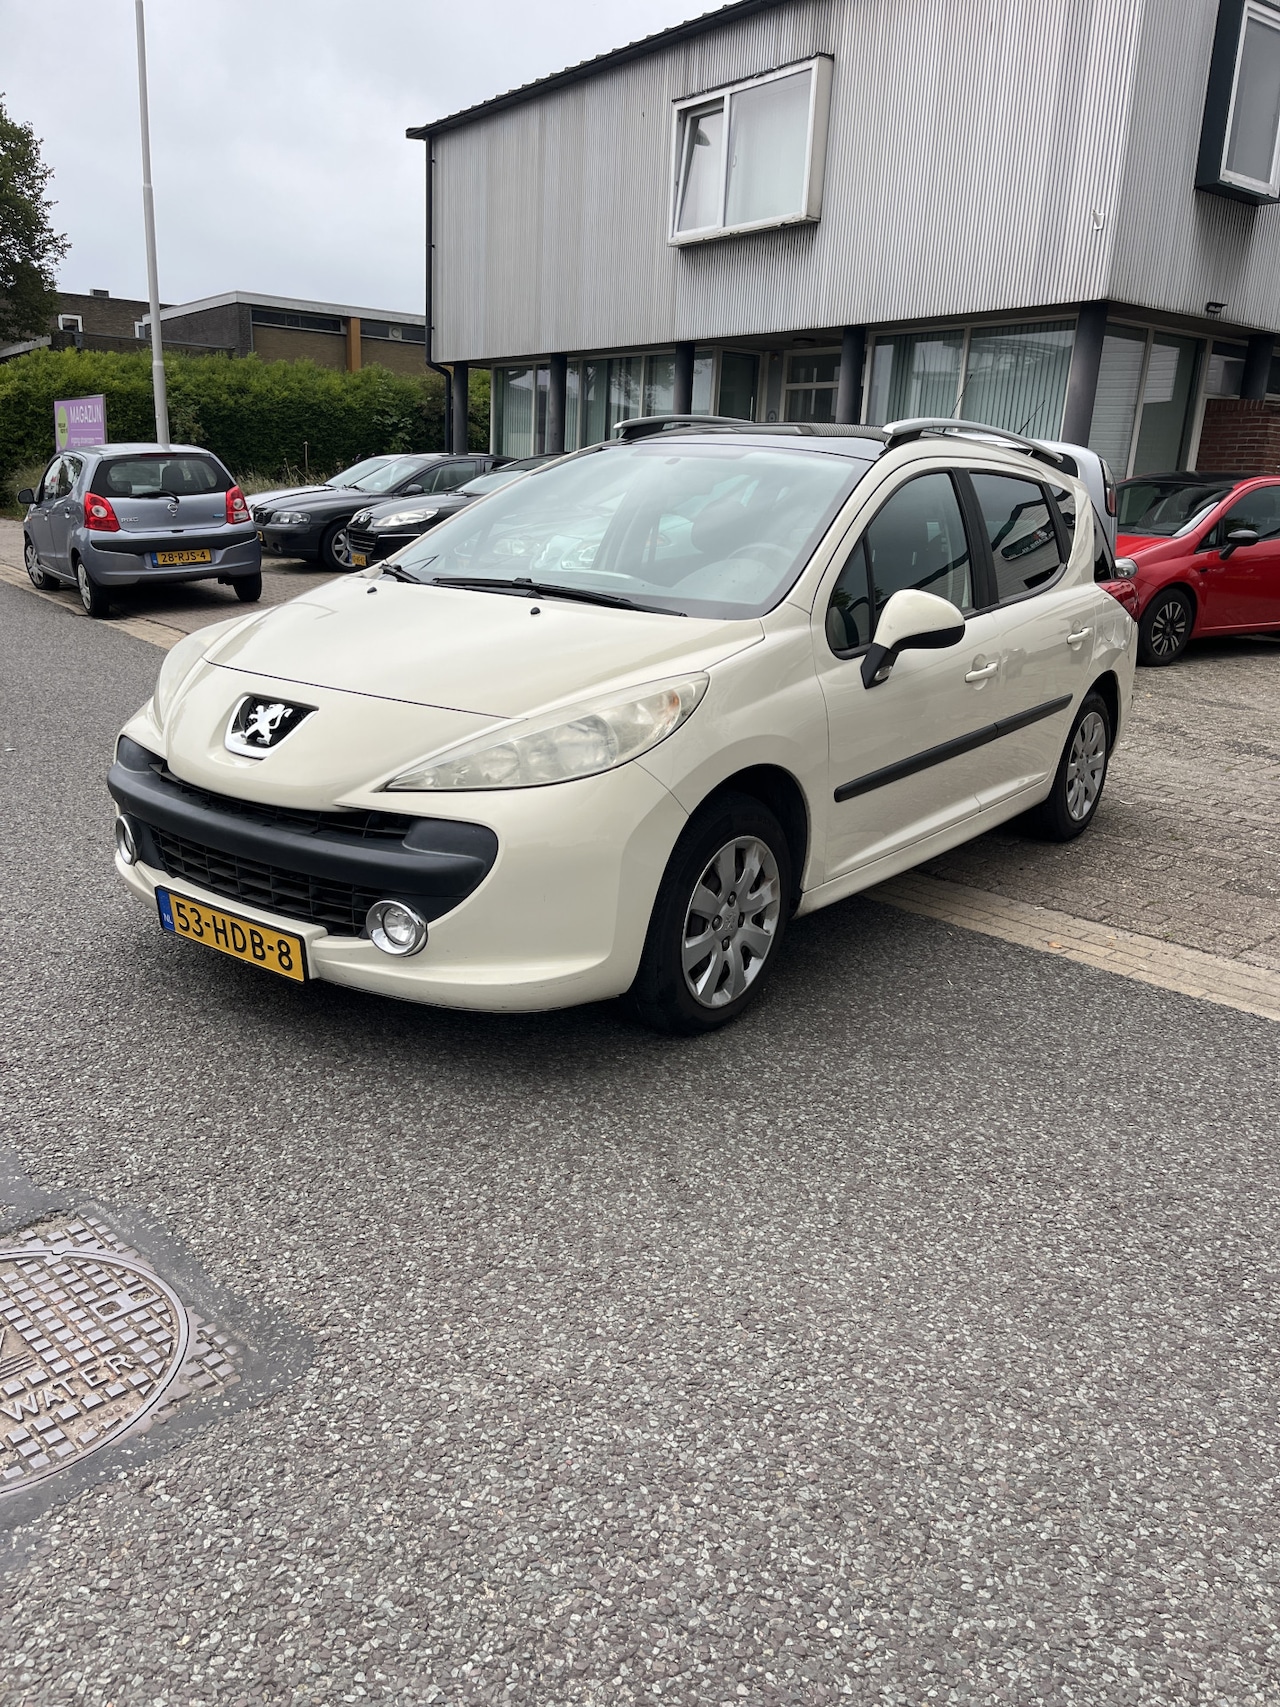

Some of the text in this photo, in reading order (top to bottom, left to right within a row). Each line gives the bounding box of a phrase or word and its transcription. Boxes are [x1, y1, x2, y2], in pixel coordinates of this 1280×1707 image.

[70, 404, 102, 423] MAGAZIJN
[161, 551, 206, 563] 28-RJS-4
[163, 913, 173, 925] NL
[175, 901, 293, 971] 53-HDB-8
[0, 1352, 135, 1423] WATER
